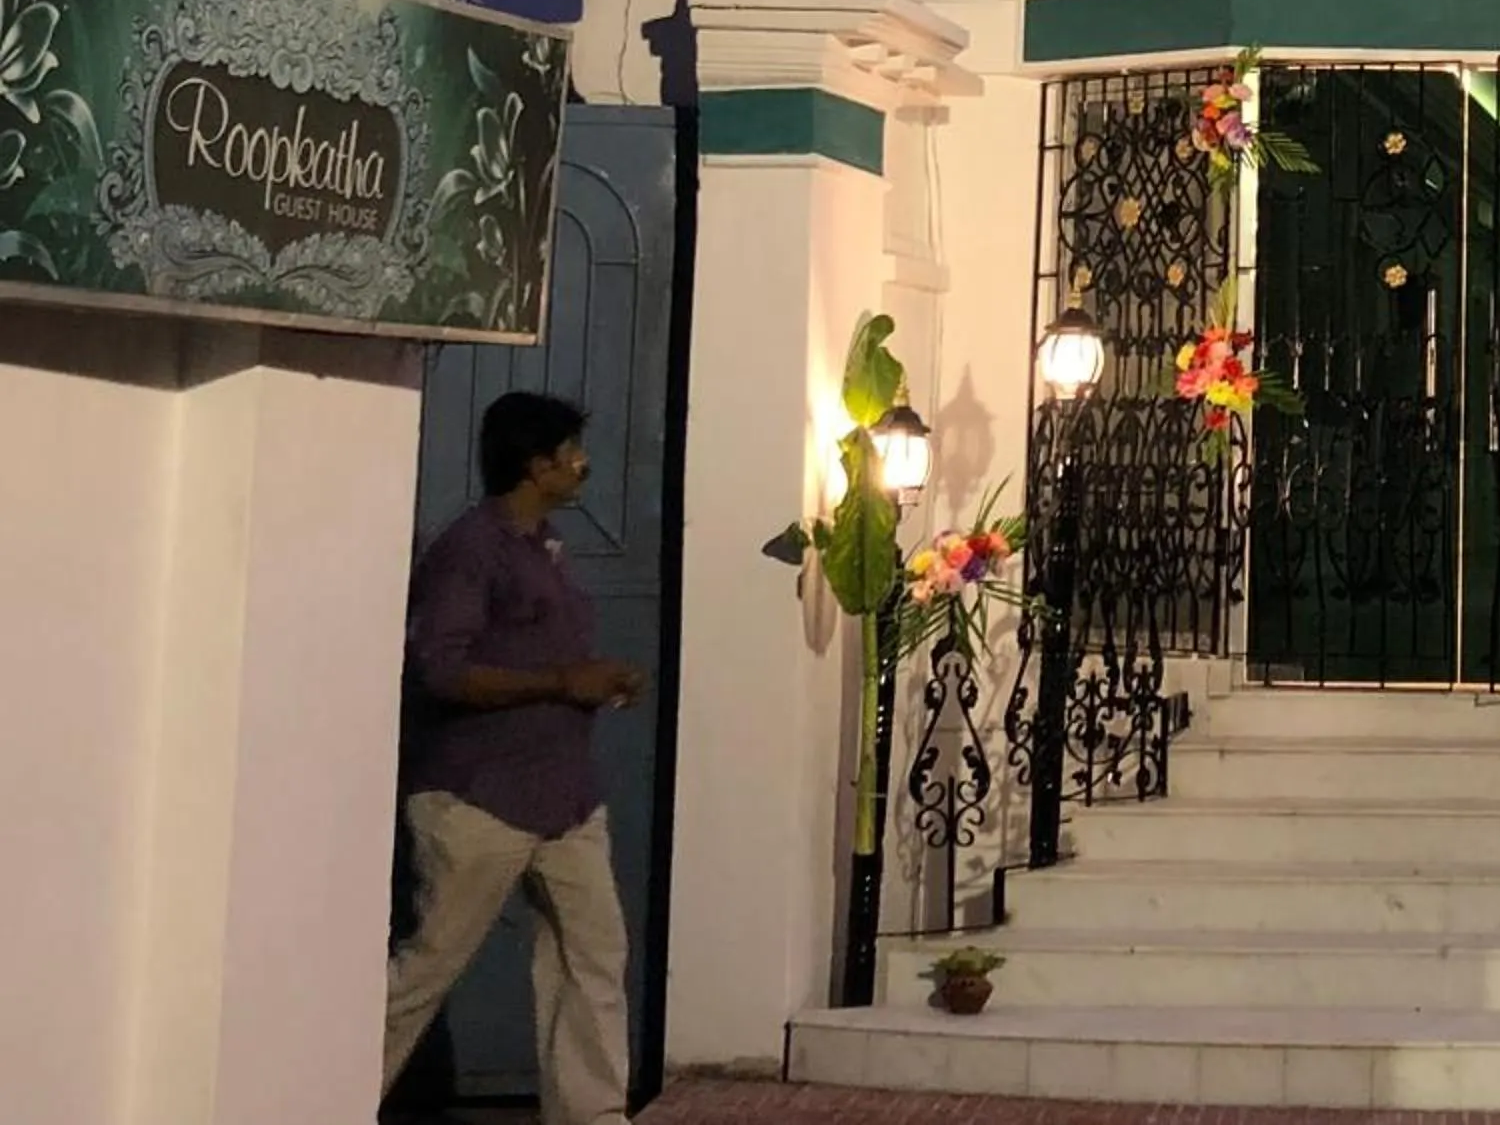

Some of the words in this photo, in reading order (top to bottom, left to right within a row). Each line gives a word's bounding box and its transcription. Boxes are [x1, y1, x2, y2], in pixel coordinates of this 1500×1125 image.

[166, 77, 384, 210] Roopkatha
[273, 192, 321, 221] GUEST
[327, 202, 379, 230] HOUSE
